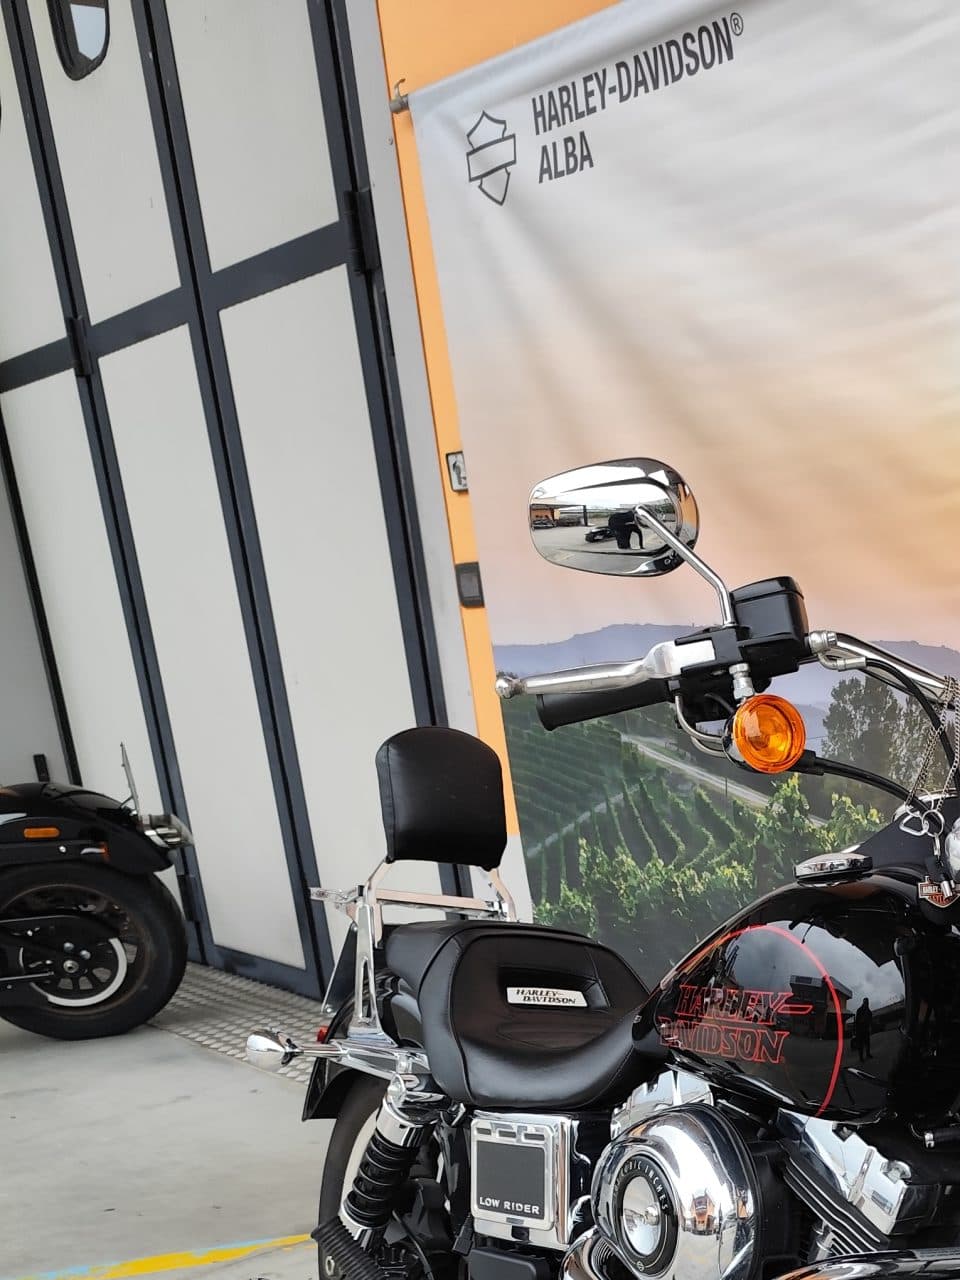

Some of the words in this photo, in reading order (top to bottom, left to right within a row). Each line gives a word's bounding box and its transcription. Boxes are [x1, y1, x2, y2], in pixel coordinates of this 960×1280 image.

[538, 130, 595, 184] ALBA
[523, 995, 576, 1005] DAVIDSON
[657, 1015, 791, 1064] DAVIDSON
[479, 1196, 501, 1208] LOW
[503, 1200, 541, 1215] RIDER
[644, 1164, 669, 1210] INCHES
